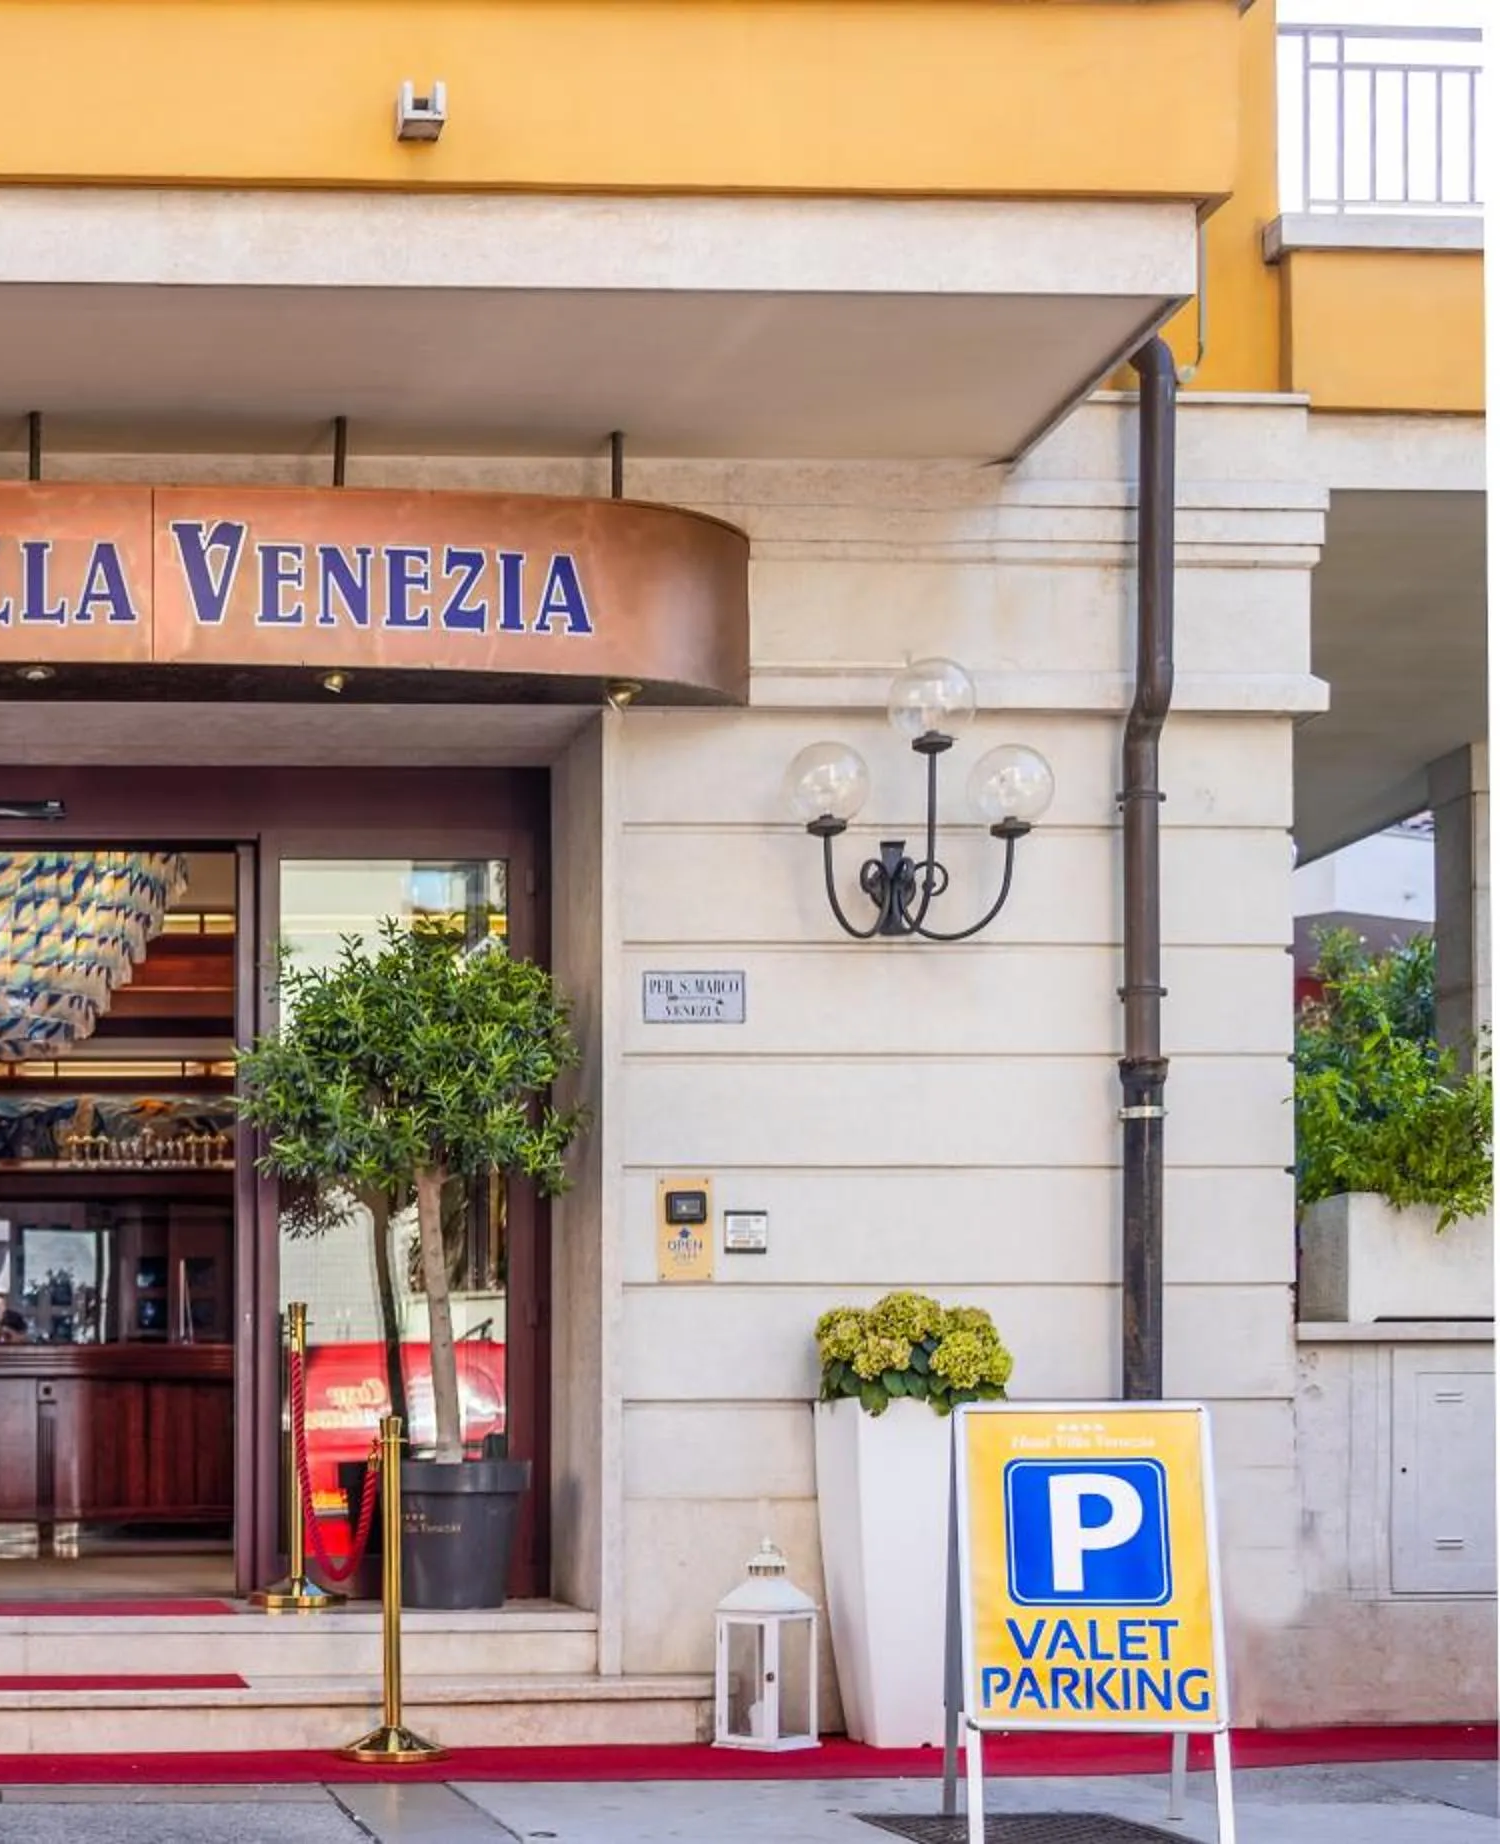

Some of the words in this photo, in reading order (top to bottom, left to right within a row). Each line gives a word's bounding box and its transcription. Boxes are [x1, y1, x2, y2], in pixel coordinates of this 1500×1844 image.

[169, 519, 594, 635] VENEZIA
[649, 979, 673, 994] PER
[695, 979, 740, 994] MARCO
[665, 1005, 721, 1017] VENEZIA
[1048, 1472, 1144, 1593] P
[1005, 1618, 1179, 1662] VALET
[981, 1667, 1211, 1713] PARKING
